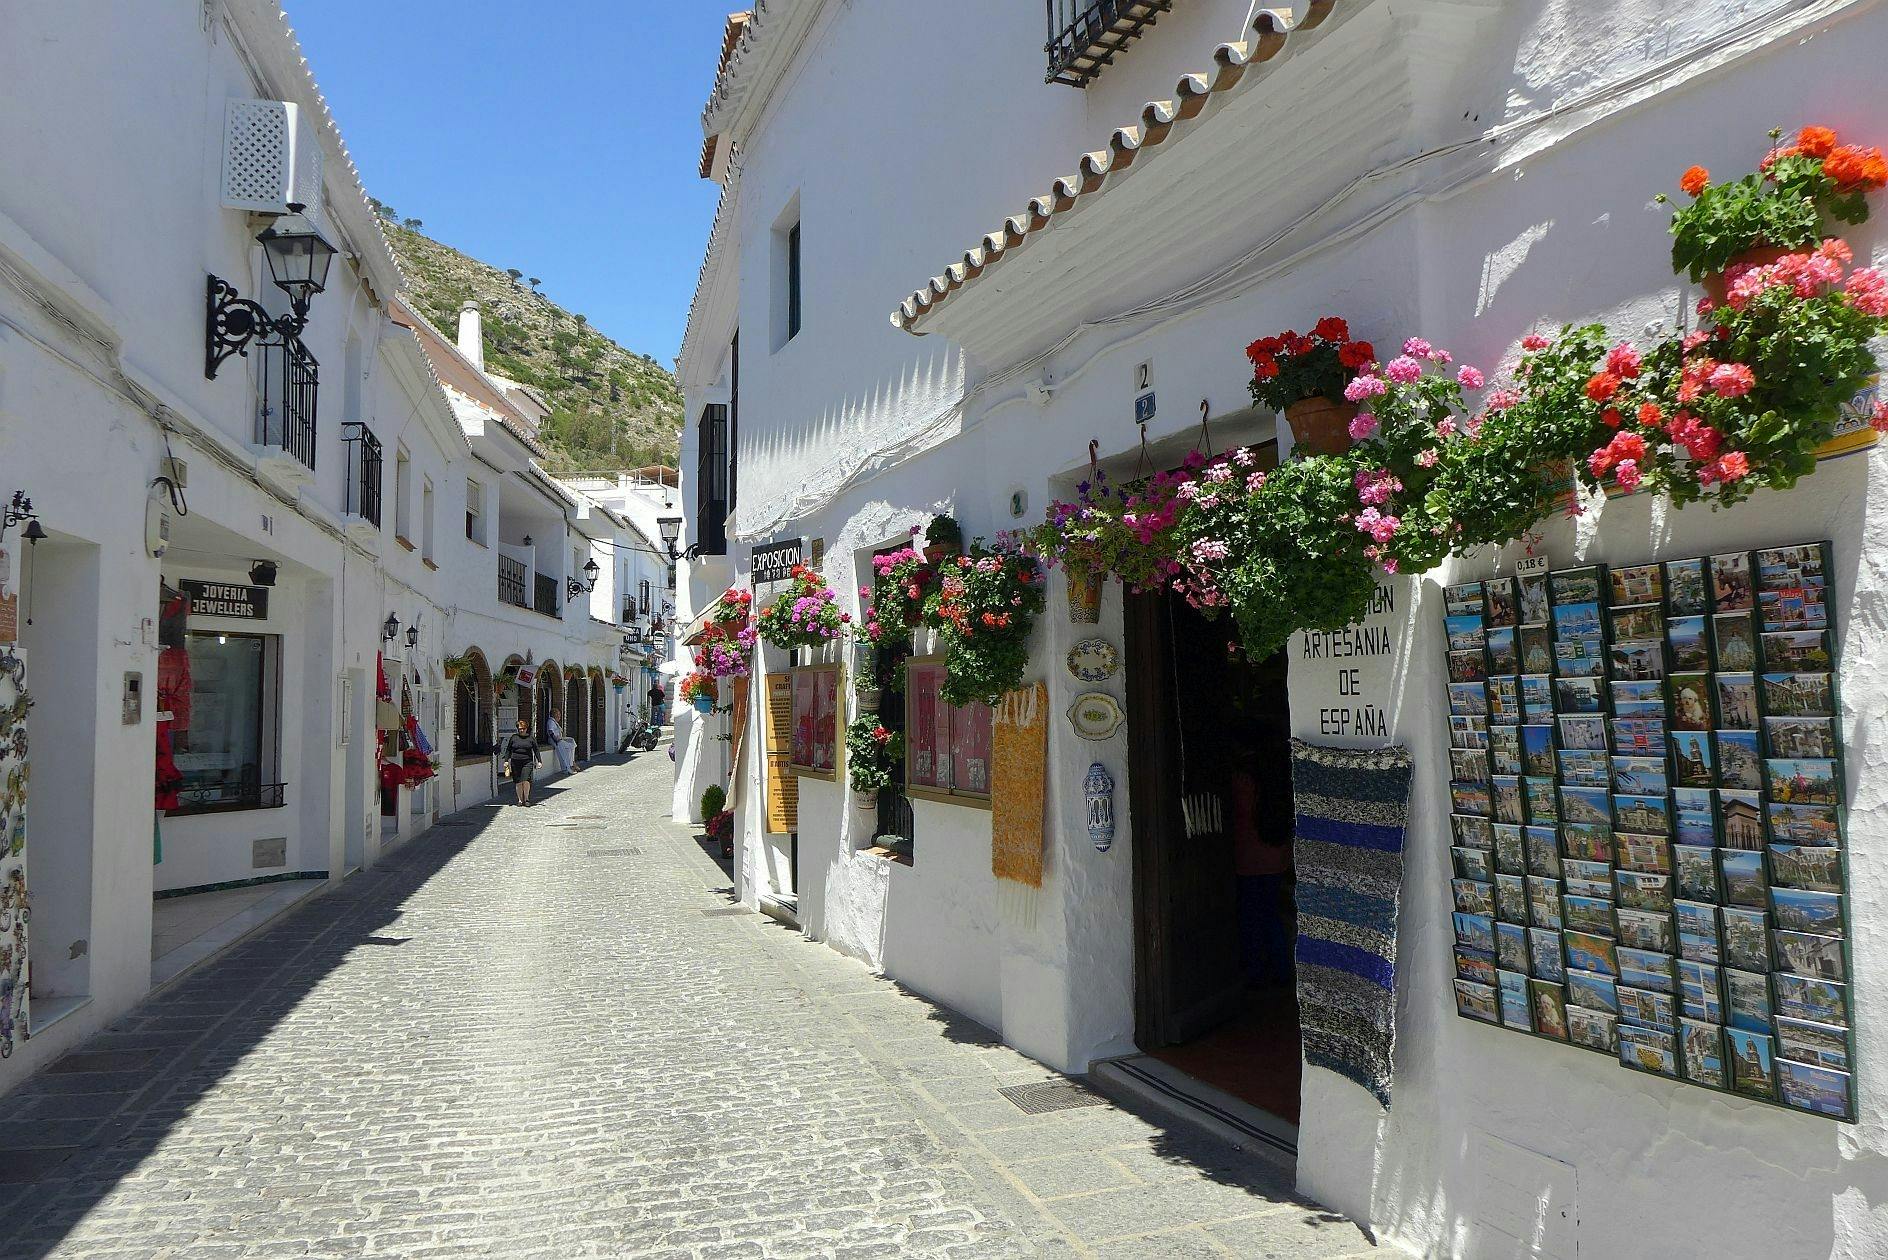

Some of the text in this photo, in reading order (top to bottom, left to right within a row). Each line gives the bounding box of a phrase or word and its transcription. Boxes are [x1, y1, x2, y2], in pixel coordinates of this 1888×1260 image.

[1140, 363, 1149, 390] 2
[752, 546, 800, 572] EXPOSICION
[1517, 557, 1545, 571] 0,18 €
[192, 599, 254, 616] JEWELLERS
[1303, 626, 1391, 659] ARTESANIA
[1339, 669, 1361, 696] DE
[1320, 704, 1388, 737] ESPAÑA
